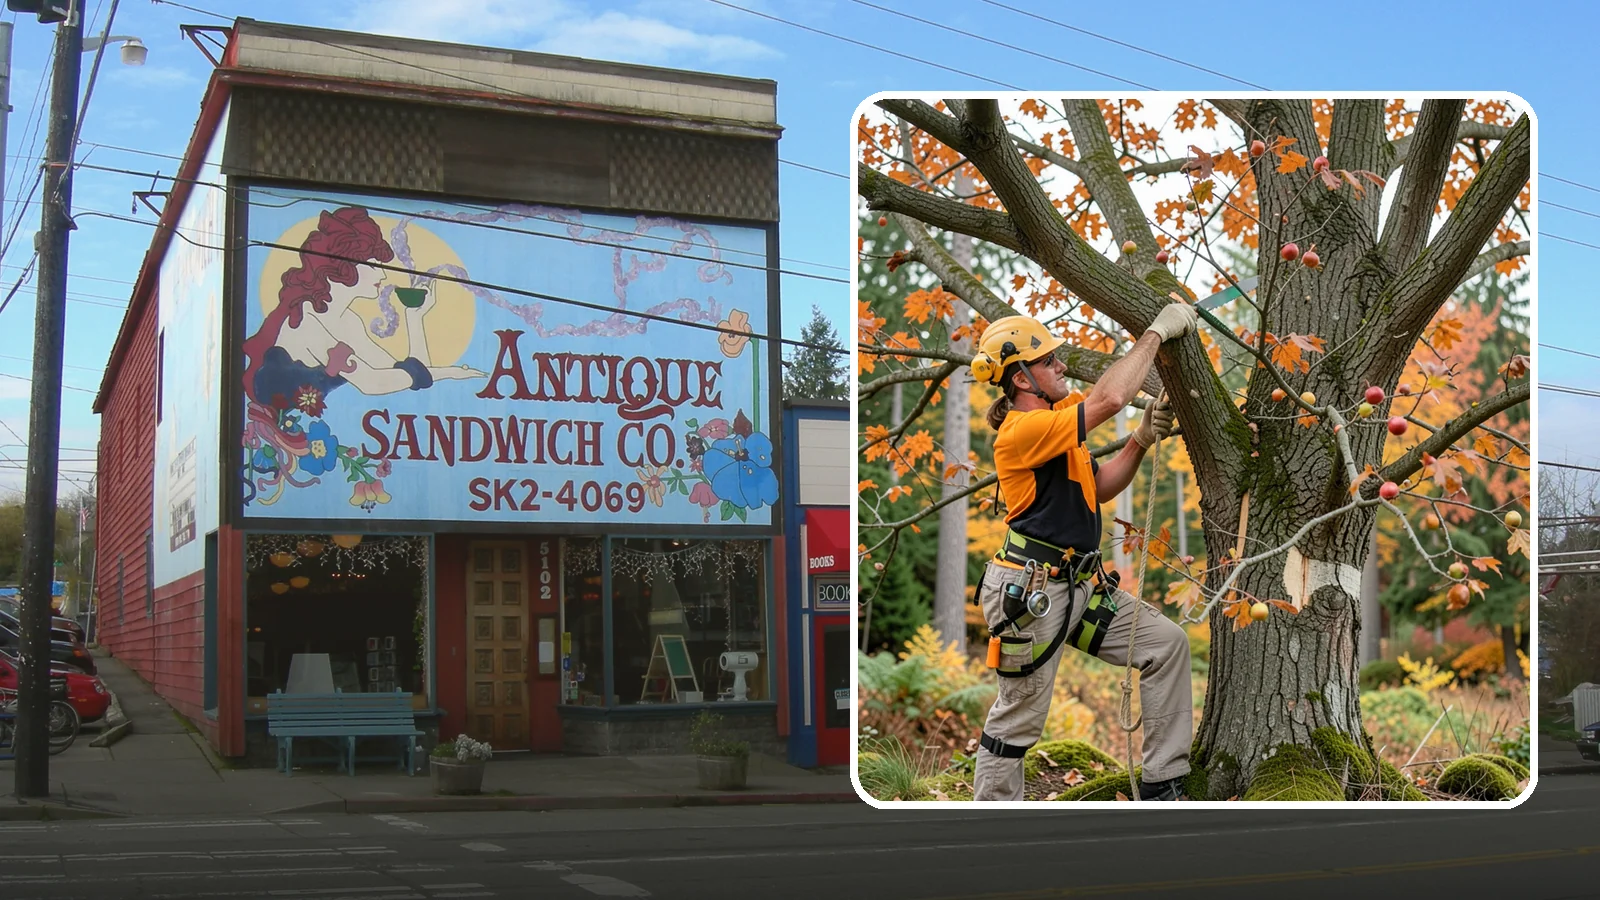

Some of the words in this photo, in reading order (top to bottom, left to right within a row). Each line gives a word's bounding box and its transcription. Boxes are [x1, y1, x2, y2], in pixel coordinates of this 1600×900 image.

[475, 328, 724, 421] ANTIQUE
[361, 408, 605, 467] SANDWICH
[617, 422, 684, 468] CO.
[468, 476, 646, 513] SK2-4069
[540, 541, 552, 600] 5102
[809, 555, 835, 569] BOOKS
